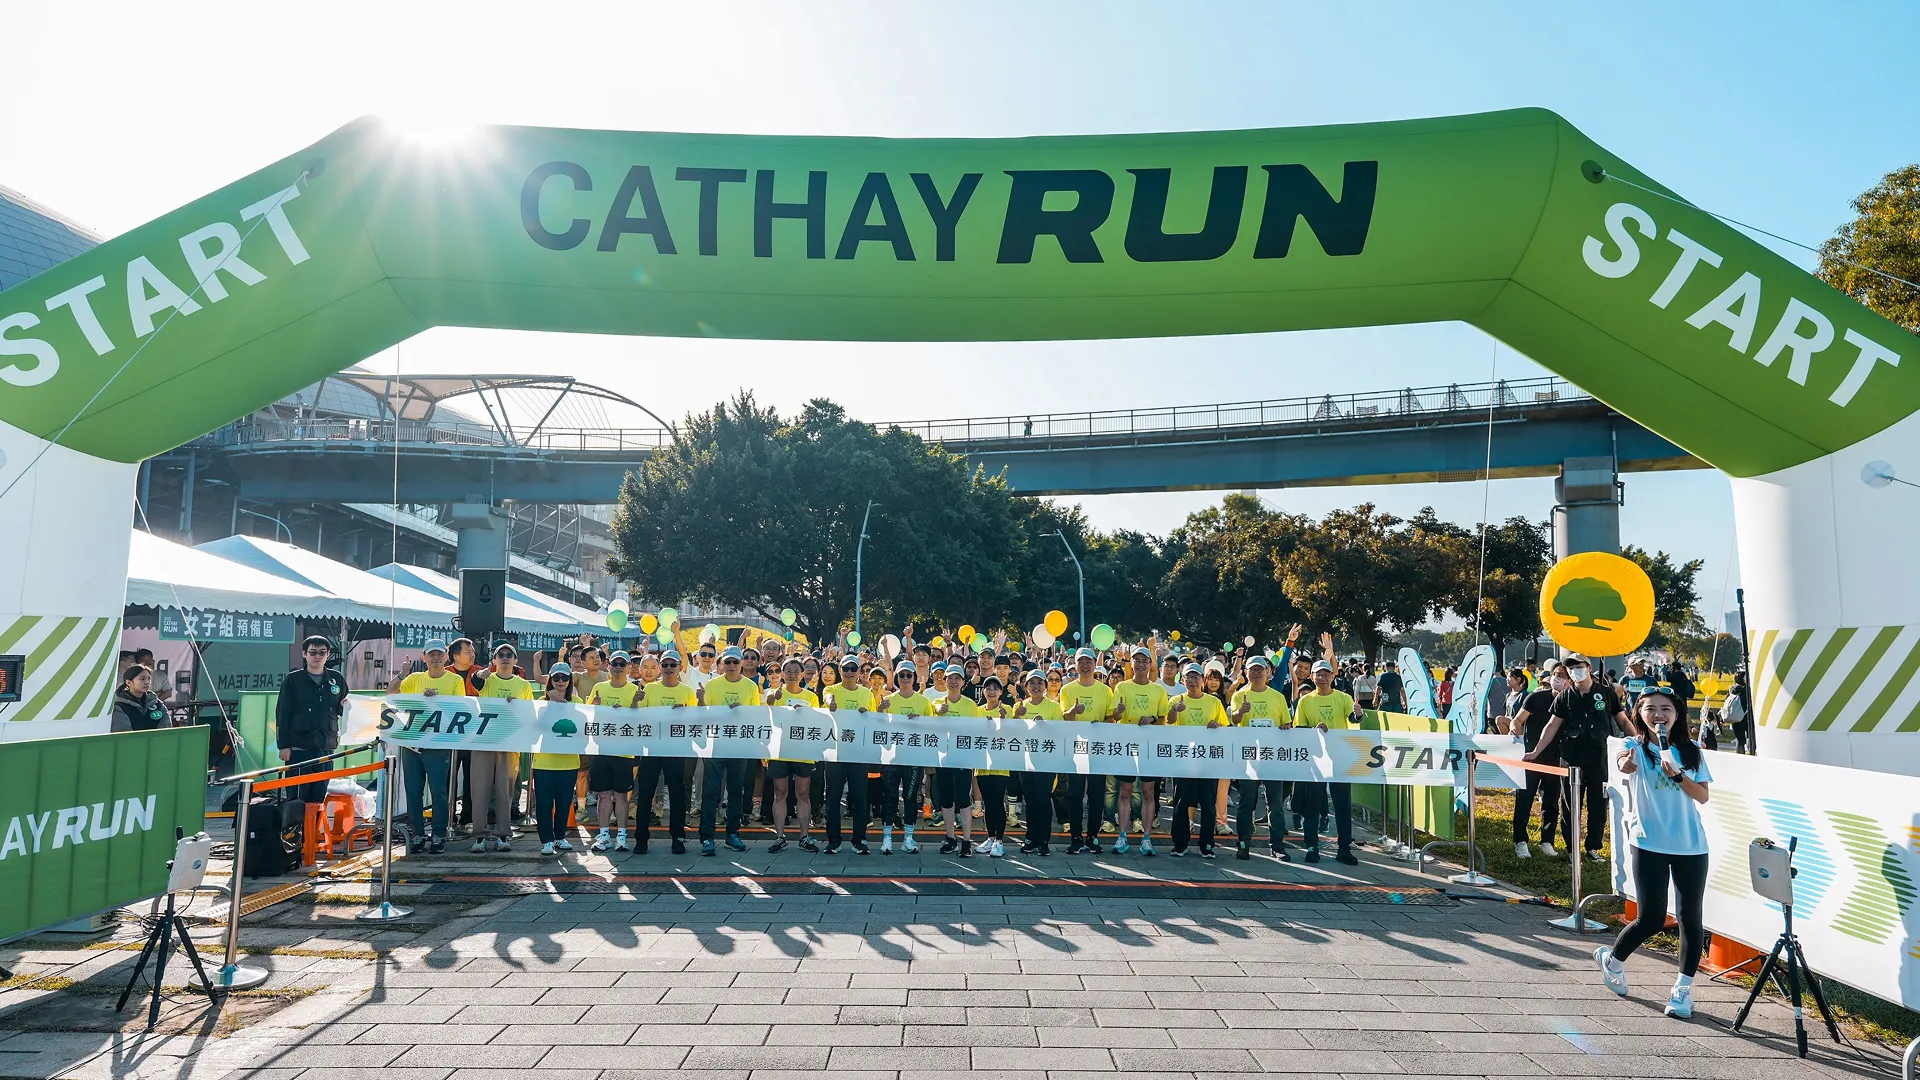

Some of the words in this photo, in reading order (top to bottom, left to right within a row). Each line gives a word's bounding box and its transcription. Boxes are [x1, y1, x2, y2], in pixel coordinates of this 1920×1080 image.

[519, 160, 984, 263] CATHAY
[996, 160, 1380, 264] RUN
[0, 184, 311, 387] START
[1582, 202, 1901, 408] START
[183, 611, 274, 637] 女子組預備區
[376, 708, 499, 736] START
[584, 721, 653, 738] 國泰金控
[669, 723, 774, 740] 國泰世華銀行
[789, 725, 856, 743] 國泰人壽
[872, 730, 940, 748] 國泰產險
[956, 735, 1057, 754] 國泰綜合證券
[1073, 740, 1140, 757] 國泰投信
[1156, 743, 1225, 760] 國泰投顧
[1241, 745, 1310, 762] 國泰創投
[51, 794, 157, 850] RUN
